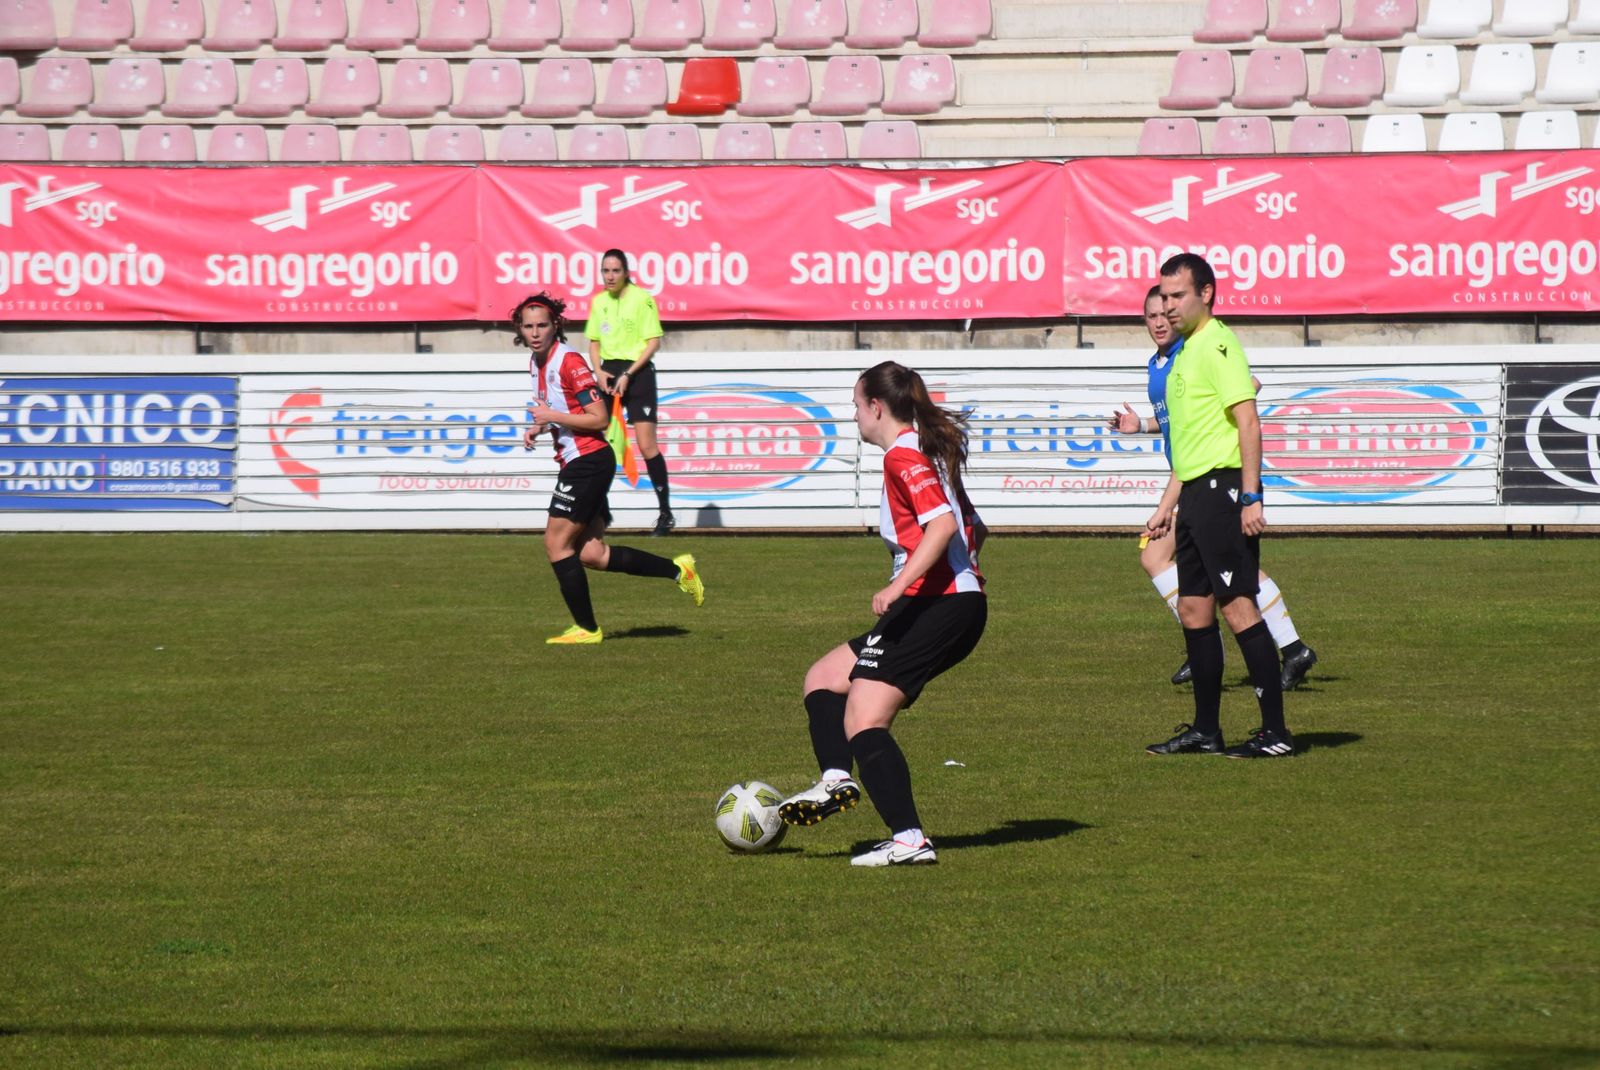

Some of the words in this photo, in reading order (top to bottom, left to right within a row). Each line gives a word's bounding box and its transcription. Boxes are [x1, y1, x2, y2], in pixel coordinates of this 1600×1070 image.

[76, 201, 117, 227] sgc
[370, 201, 412, 228] sgc
[661, 200, 702, 227] sgc
[956, 197, 999, 224] sgc
[1255, 191, 1298, 220] sgc
[205, 242, 458, 297] sangregorio
[790, 238, 1046, 296] sangregorio
[1084, 234, 1346, 290] sanegorio
[1388, 240, 1600, 288] sangrego
[266, 302, 399, 312] CONSTRUCCION
[851, 299, 985, 311] CONSTRUCCION
[1453, 290, 1592, 303] CONSTRUCCION
[110, 460, 144, 476] 980
[147, 460, 182, 476] 516
[187, 460, 220, 476] 933
